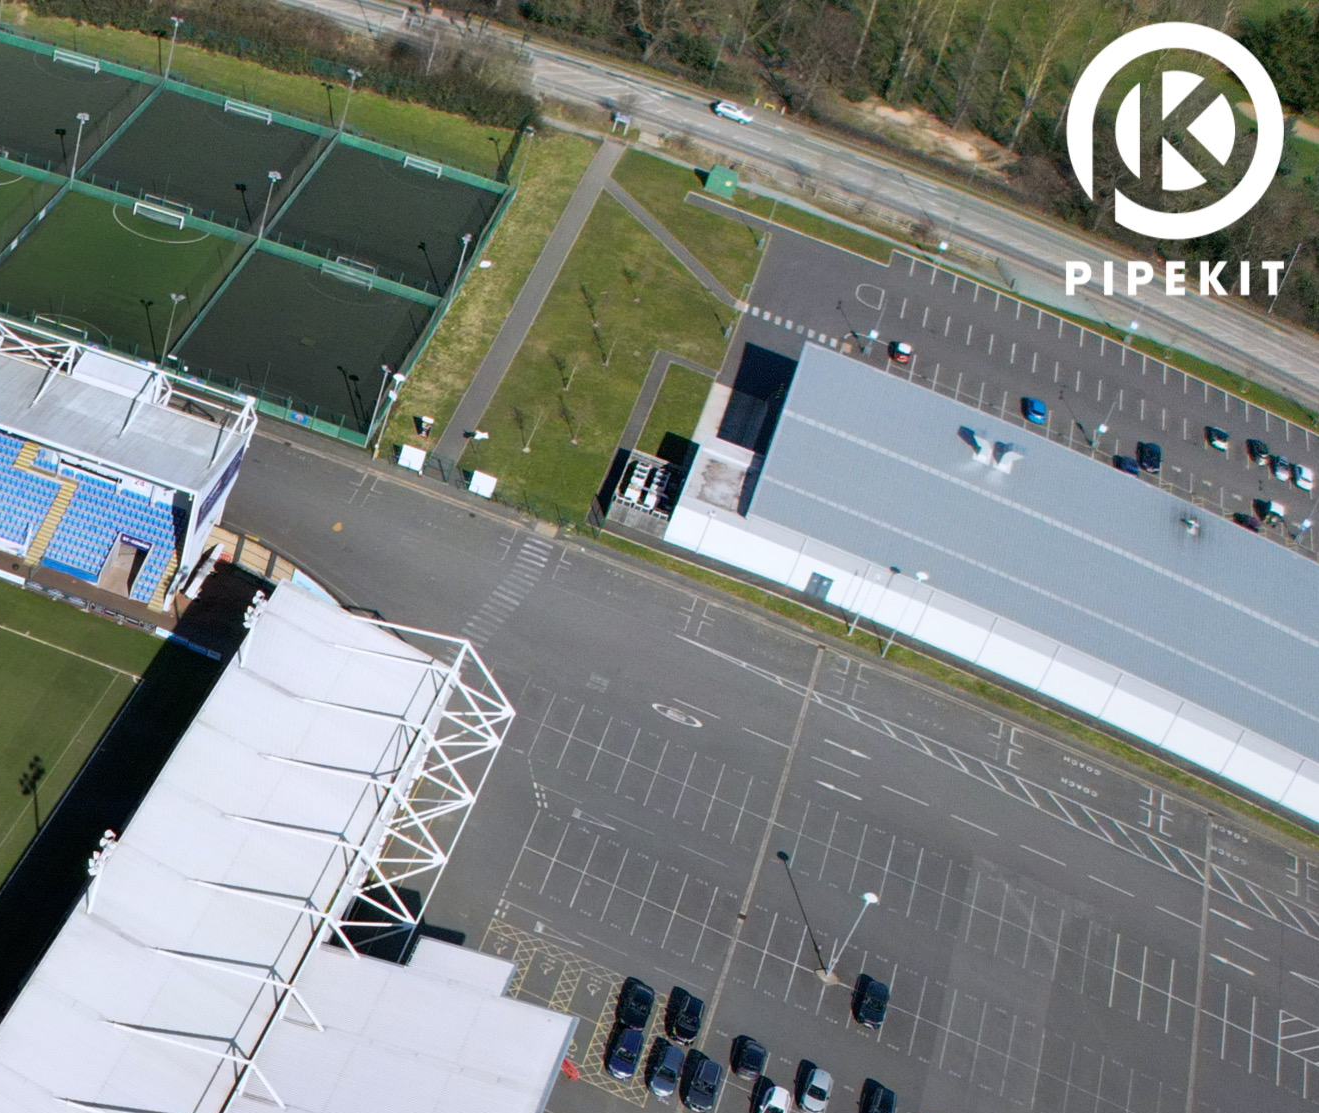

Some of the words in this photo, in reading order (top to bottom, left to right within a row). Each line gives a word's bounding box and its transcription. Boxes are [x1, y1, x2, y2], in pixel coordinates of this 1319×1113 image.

[1063, 755, 1100, 776] COACH
[1061, 776, 1097, 797] COACH
[1211, 822, 1247, 843] COACH
[1211, 845, 1247, 865] COACH
